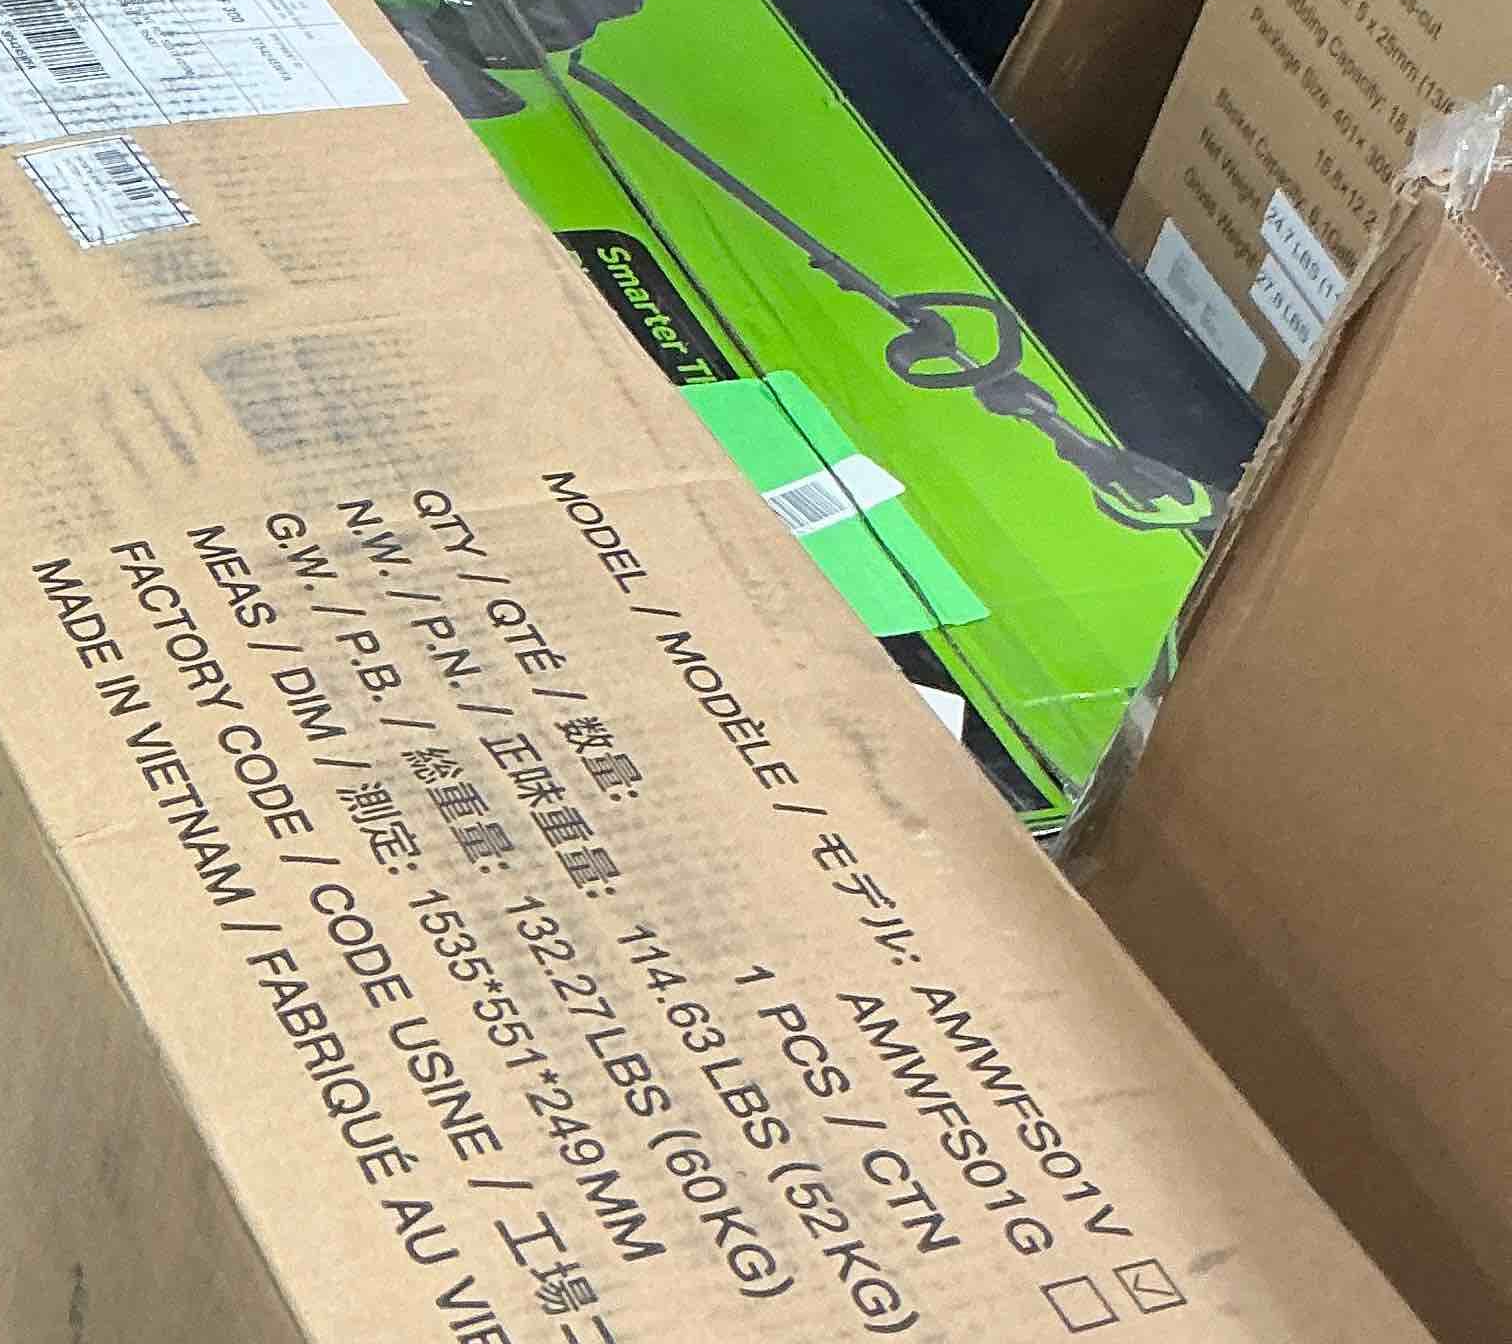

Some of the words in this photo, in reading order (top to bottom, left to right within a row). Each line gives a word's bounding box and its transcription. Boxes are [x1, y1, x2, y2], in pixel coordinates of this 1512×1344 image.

[587, 241, 689, 335] Smarter
[186, 524, 277, 629] MEAS
[265, 511, 338, 592] G.W.
[338, 497, 413, 579] N.W.
[31, 557, 122, 670] MADE
[109, 538, 244, 711] FACTORY
[310, 603, 367, 616] /
[385, 590, 442, 602] /
[246, 642, 304, 652] /
[336, 628, 402, 704] P.B.
[410, 613, 482, 691] P.N.
[94, 674, 152, 718] IN
[269, 665, 348, 744] DIM
[379, 716, 437, 729] /
[456, 702, 514, 716] /
[216, 724, 314, 840] CODE
[313, 757, 372, 769] /
[124, 721, 256, 908] VIETNAM
[542, 471, 649, 595] MODEL
[630, 605, 681, 617] /
[656, 630, 799, 791] MODÈLE
[772, 802, 828, 816] /
[911, 984, 1133, 1239] AMWFS01V
[279, 854, 341, 866] /
[413, 488, 488, 558] QTY
[457, 572, 511, 585] /
[486, 598, 566, 676] QTÉ
[531, 687, 589, 701] /
[735, 964, 776, 985] 1
[758, 1003, 851, 1099] PCS
[823, 1114, 887, 1130] /
[861, 1149, 962, 1255] CTN
[220, 921, 283, 932] /
[309, 883, 413, 1009] CODE
[246, 948, 420, 1186] FABRIQUÉ
[388, 1016, 503, 1161] USINE
[837, 992, 1055, 1255] AMWFS01G
[467, 1178, 534, 1190] /
[646, 1129, 794, 1299] (60KG)
[381, 1197, 460, 1266] AU
[766, 1160, 921, 1335] (52KG)
